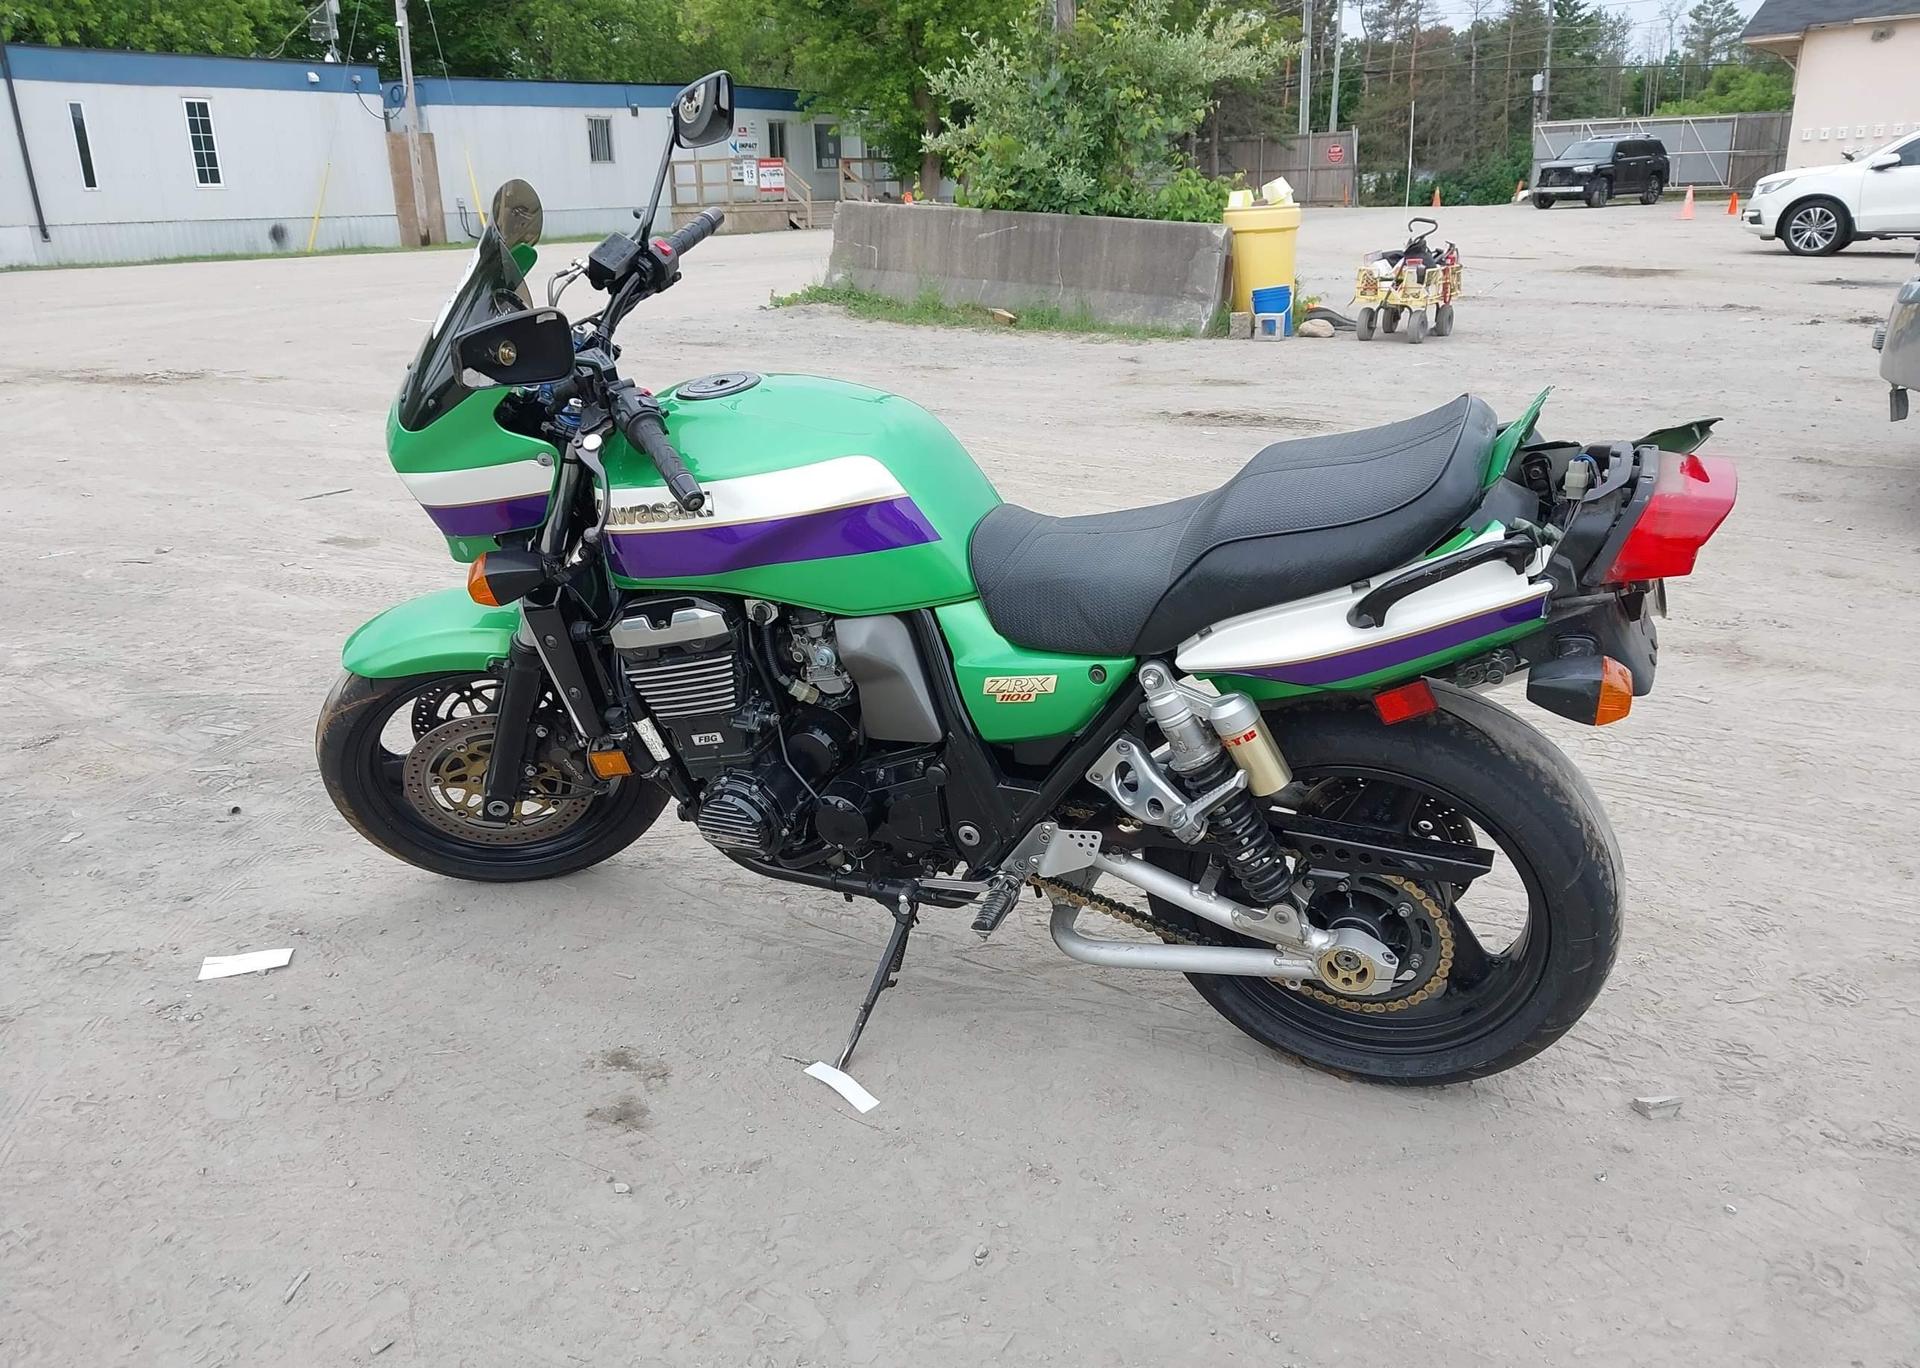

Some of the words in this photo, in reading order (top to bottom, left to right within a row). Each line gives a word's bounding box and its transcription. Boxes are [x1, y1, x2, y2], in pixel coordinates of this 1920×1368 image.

[738, 142, 758, 150] IMPACT
[986, 676, 1051, 694] ZRX
[999, 693, 1034, 702] 1100
[698, 734, 718, 743] FBG
